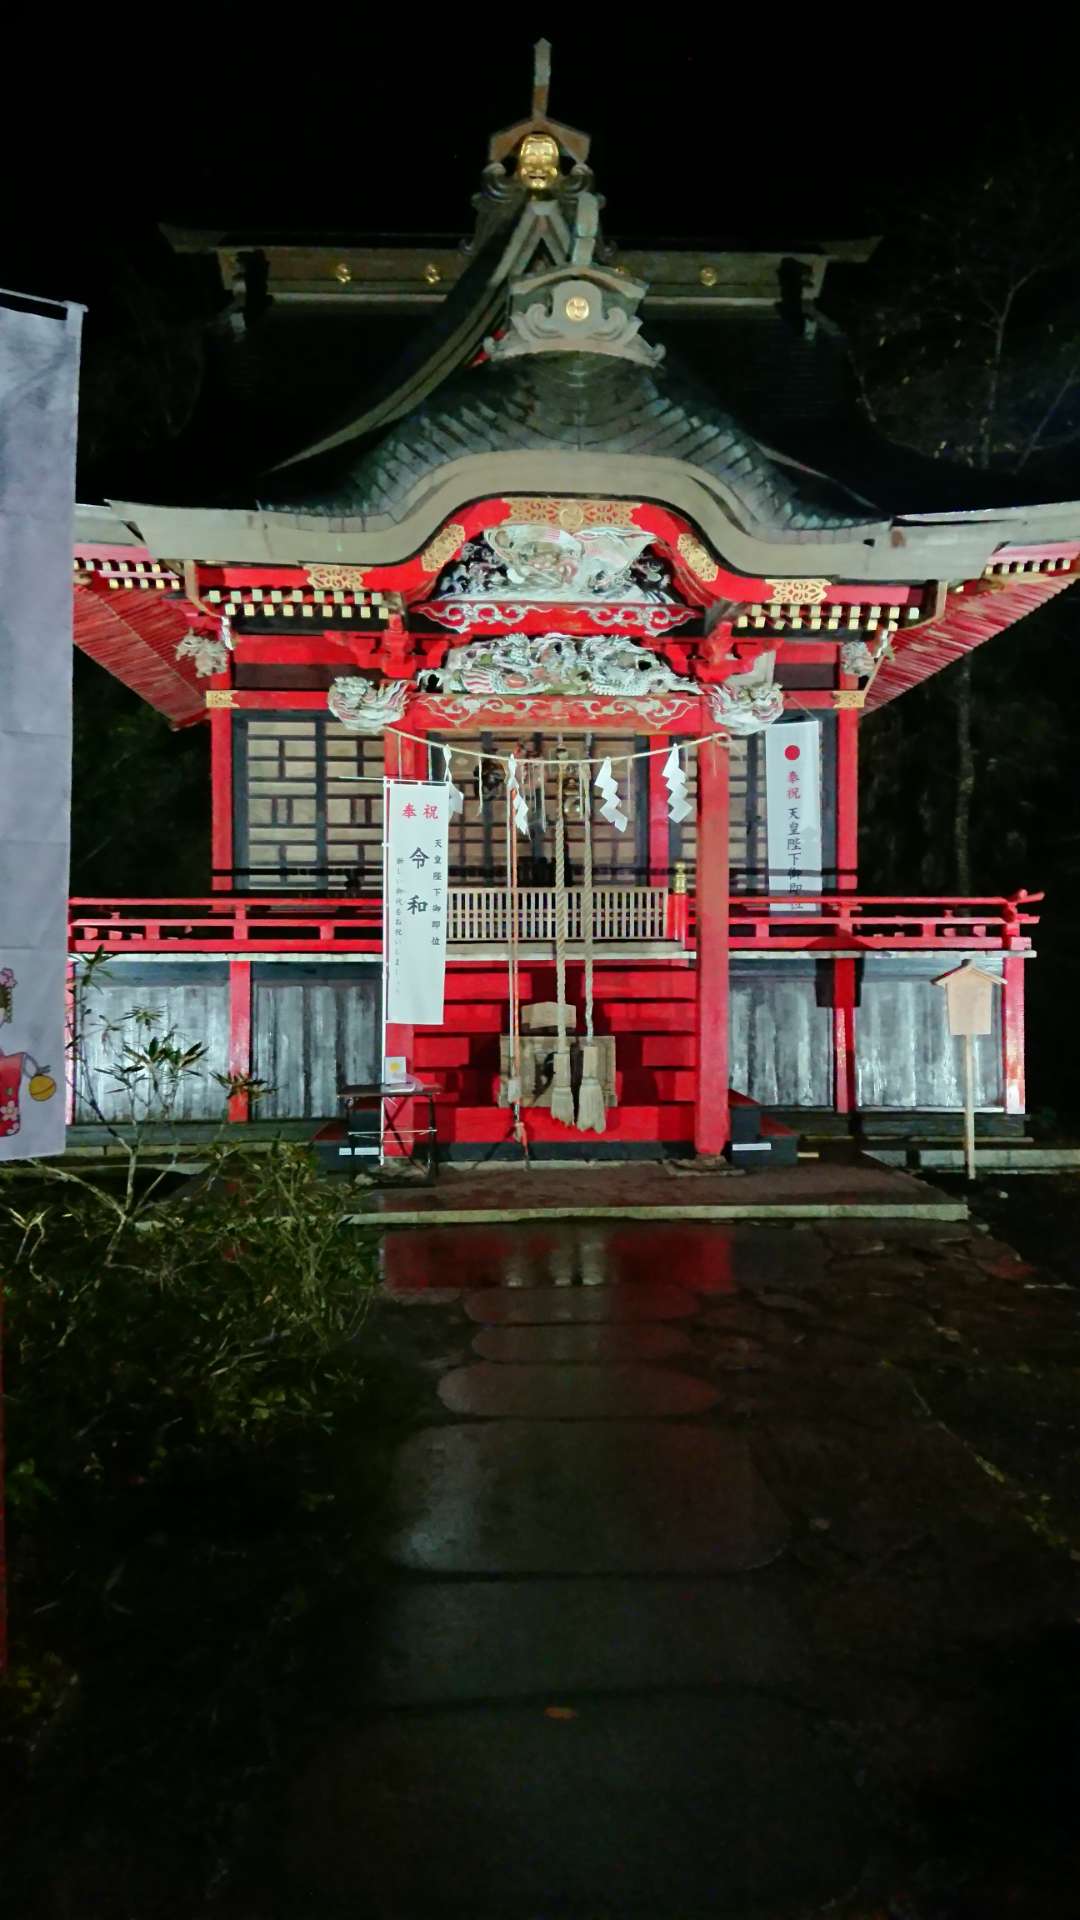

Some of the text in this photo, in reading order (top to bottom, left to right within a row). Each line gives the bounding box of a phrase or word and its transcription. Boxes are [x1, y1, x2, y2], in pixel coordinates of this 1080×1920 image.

[787, 771, 801, 800] 奉祝
[401, 803, 439, 819] 奉祝
[407, 847, 430, 915] 令和
[431, 839, 443, 946] 天皇陛下御即位
